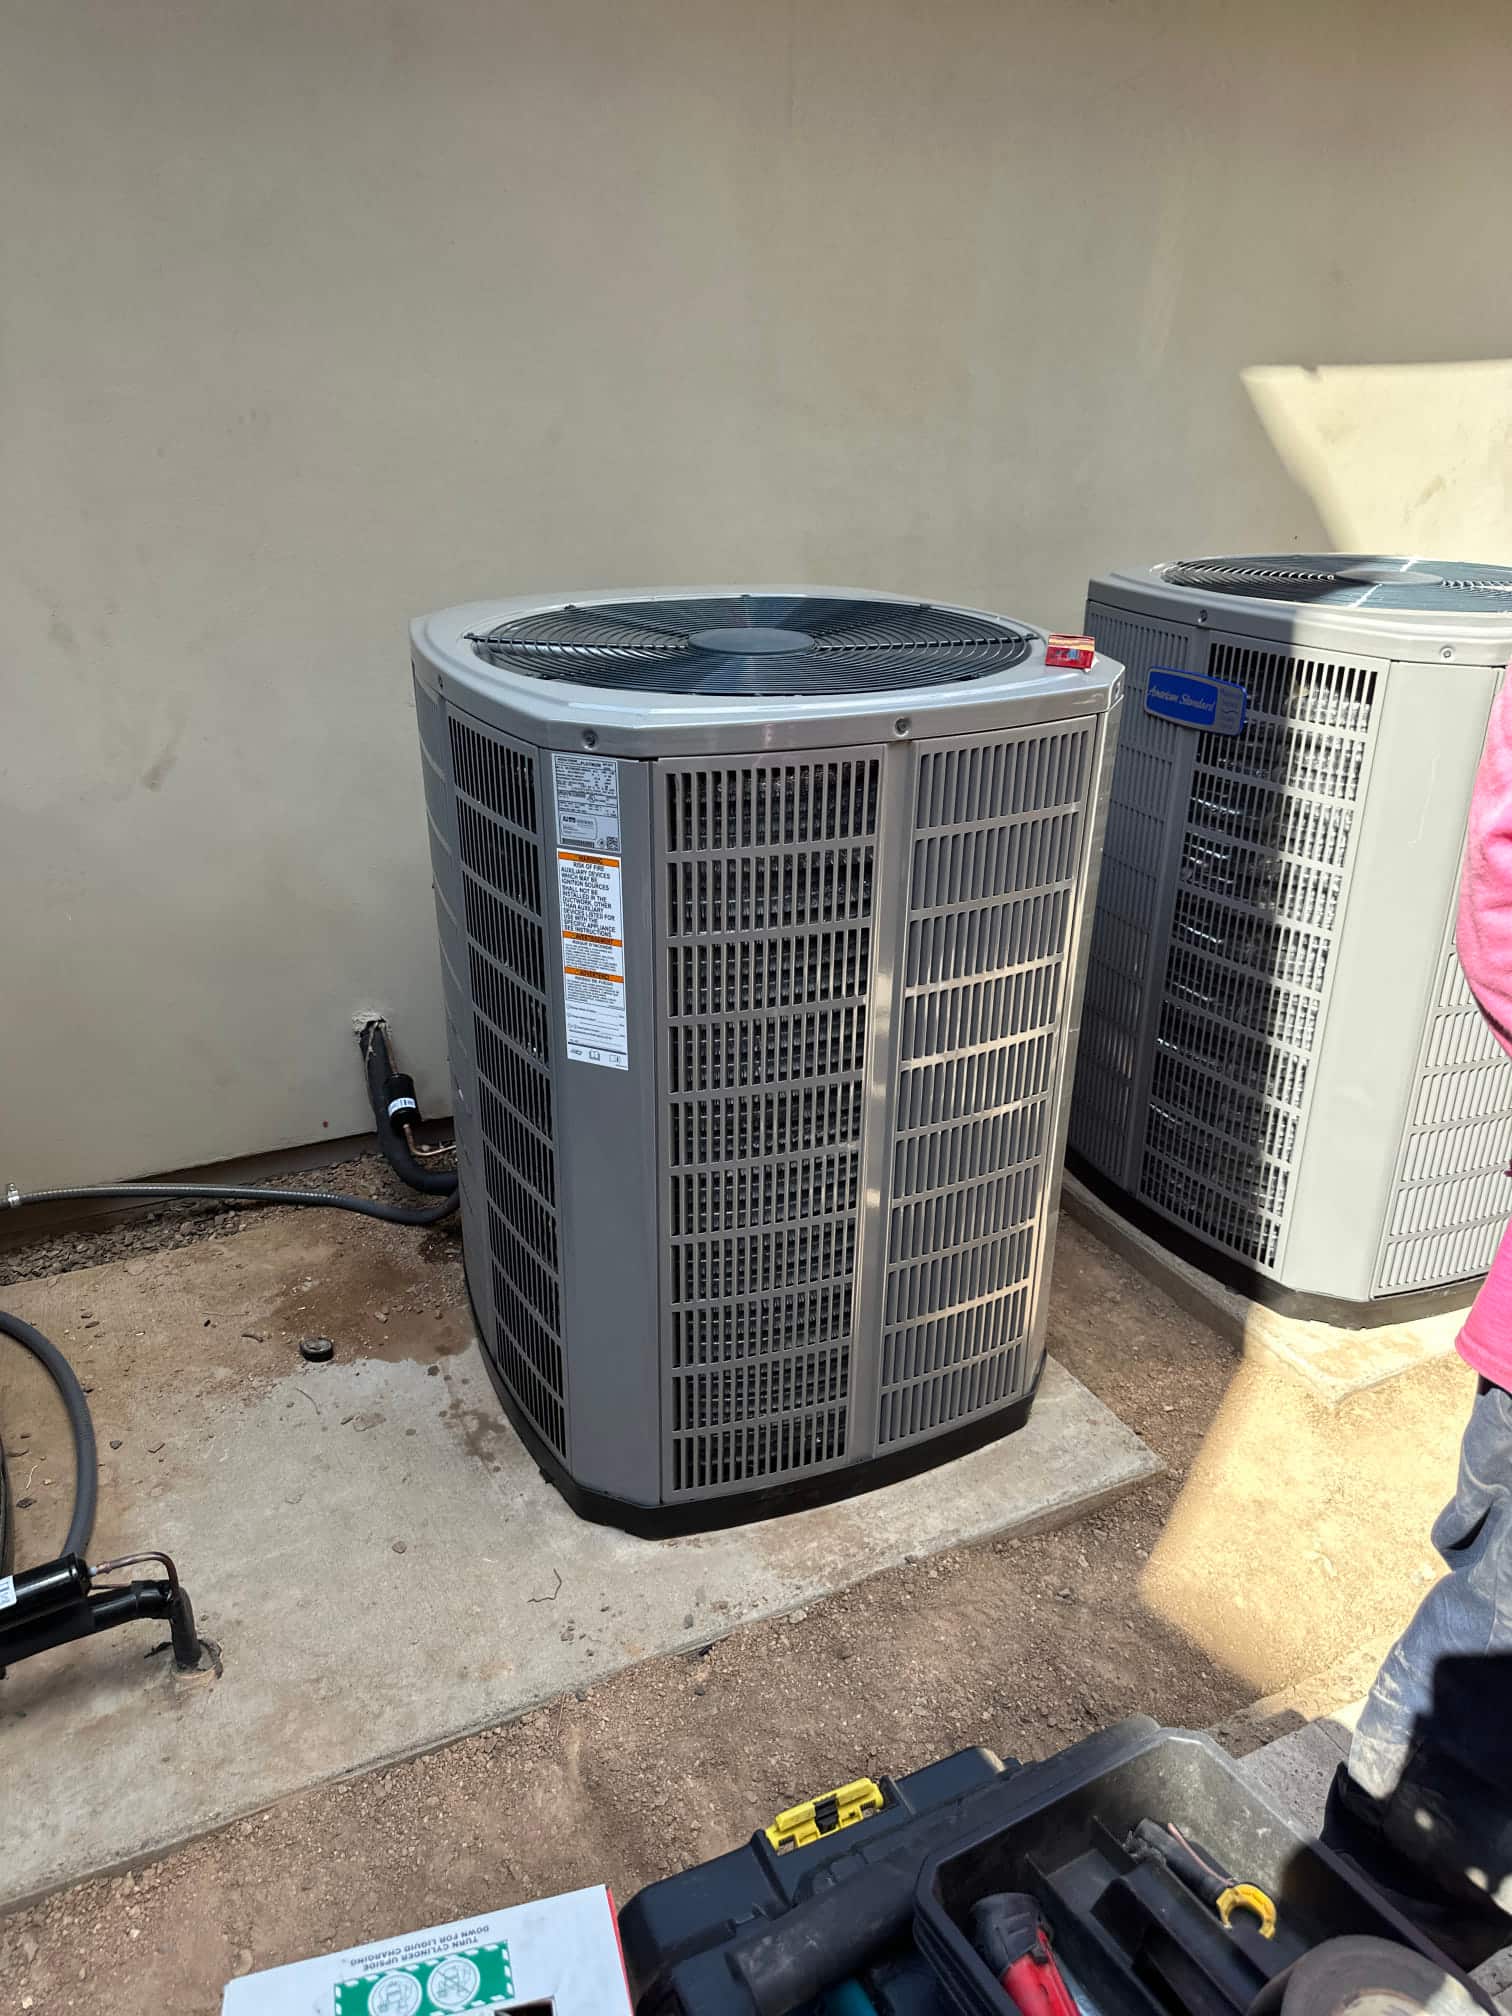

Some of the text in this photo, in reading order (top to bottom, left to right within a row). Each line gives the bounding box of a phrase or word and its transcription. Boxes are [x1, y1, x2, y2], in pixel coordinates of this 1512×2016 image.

[1147, 685, 1179, 702] American
[1179, 693, 1216, 712] Standard
[585, 882, 610, 890] SOURCES
[350, 1925, 489, 1966] DOWN FOR LIQUID CHARGING
[363, 1937, 479, 1971] TURN CYLINDER UPSIDE
